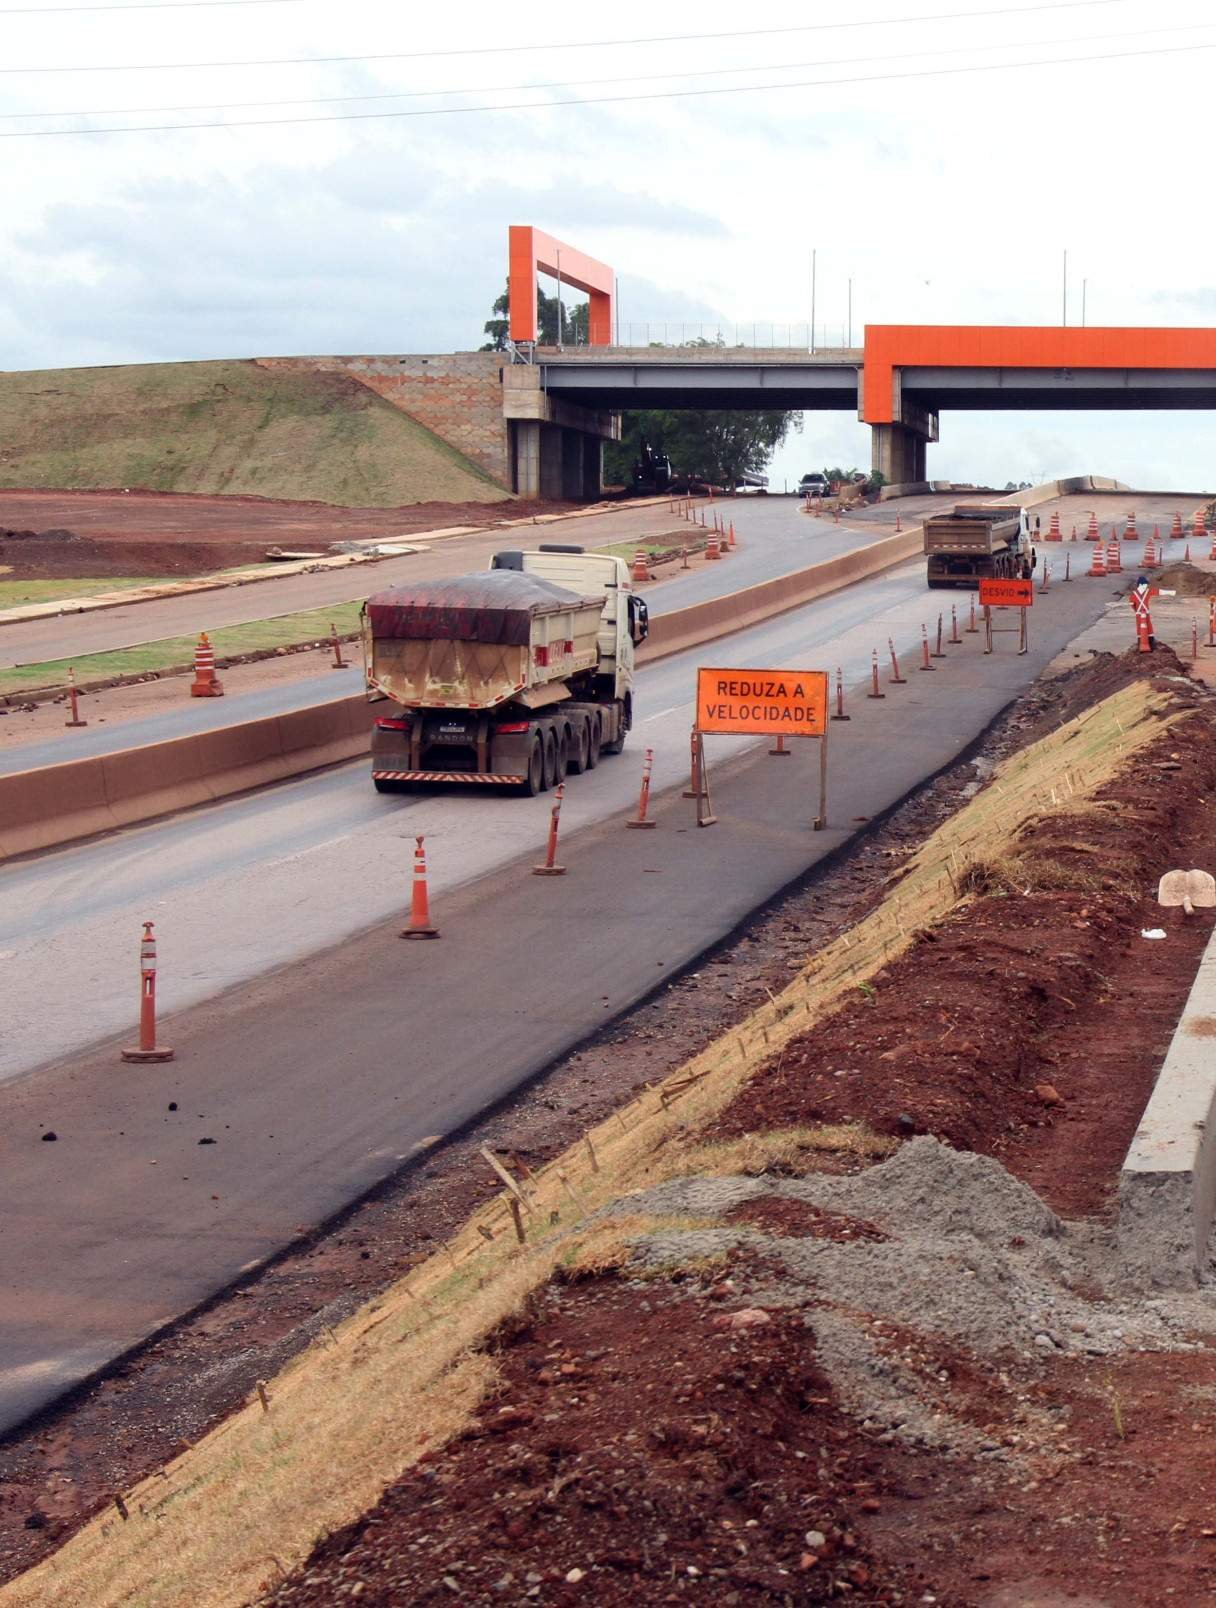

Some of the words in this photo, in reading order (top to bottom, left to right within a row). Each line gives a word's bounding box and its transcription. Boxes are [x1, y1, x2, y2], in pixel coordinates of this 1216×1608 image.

[717, 681, 788, 698] REDUZA
[793, 683, 805, 698] A
[706, 704, 816, 722] VELOCIDADE
